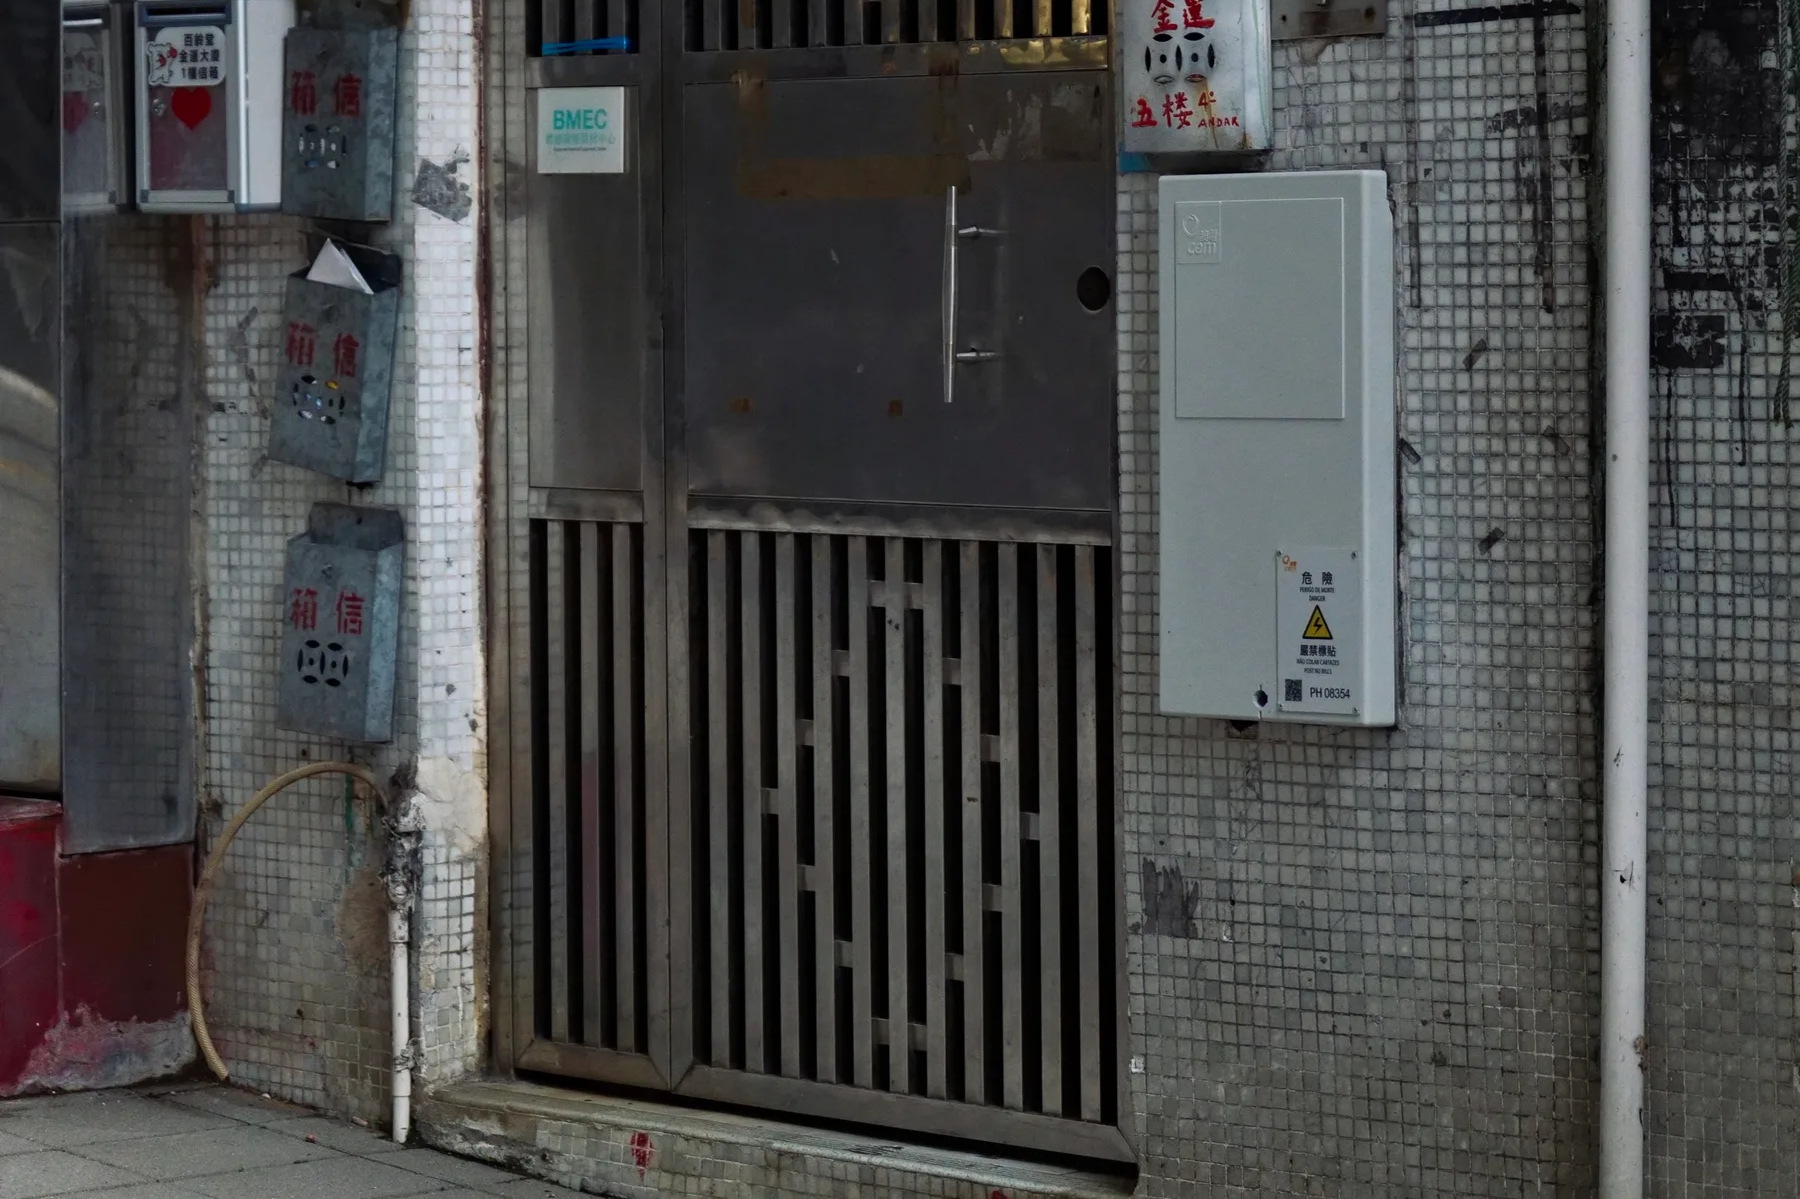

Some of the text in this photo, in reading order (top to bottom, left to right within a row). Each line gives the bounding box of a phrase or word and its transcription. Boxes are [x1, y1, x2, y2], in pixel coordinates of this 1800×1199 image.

[553, 108, 607, 130] BMEC
[1198, 116, 1240, 128] ANDAR
[1302, 571, 1333, 585] 危險
[1310, 687, 1350, 699] PH 08354
